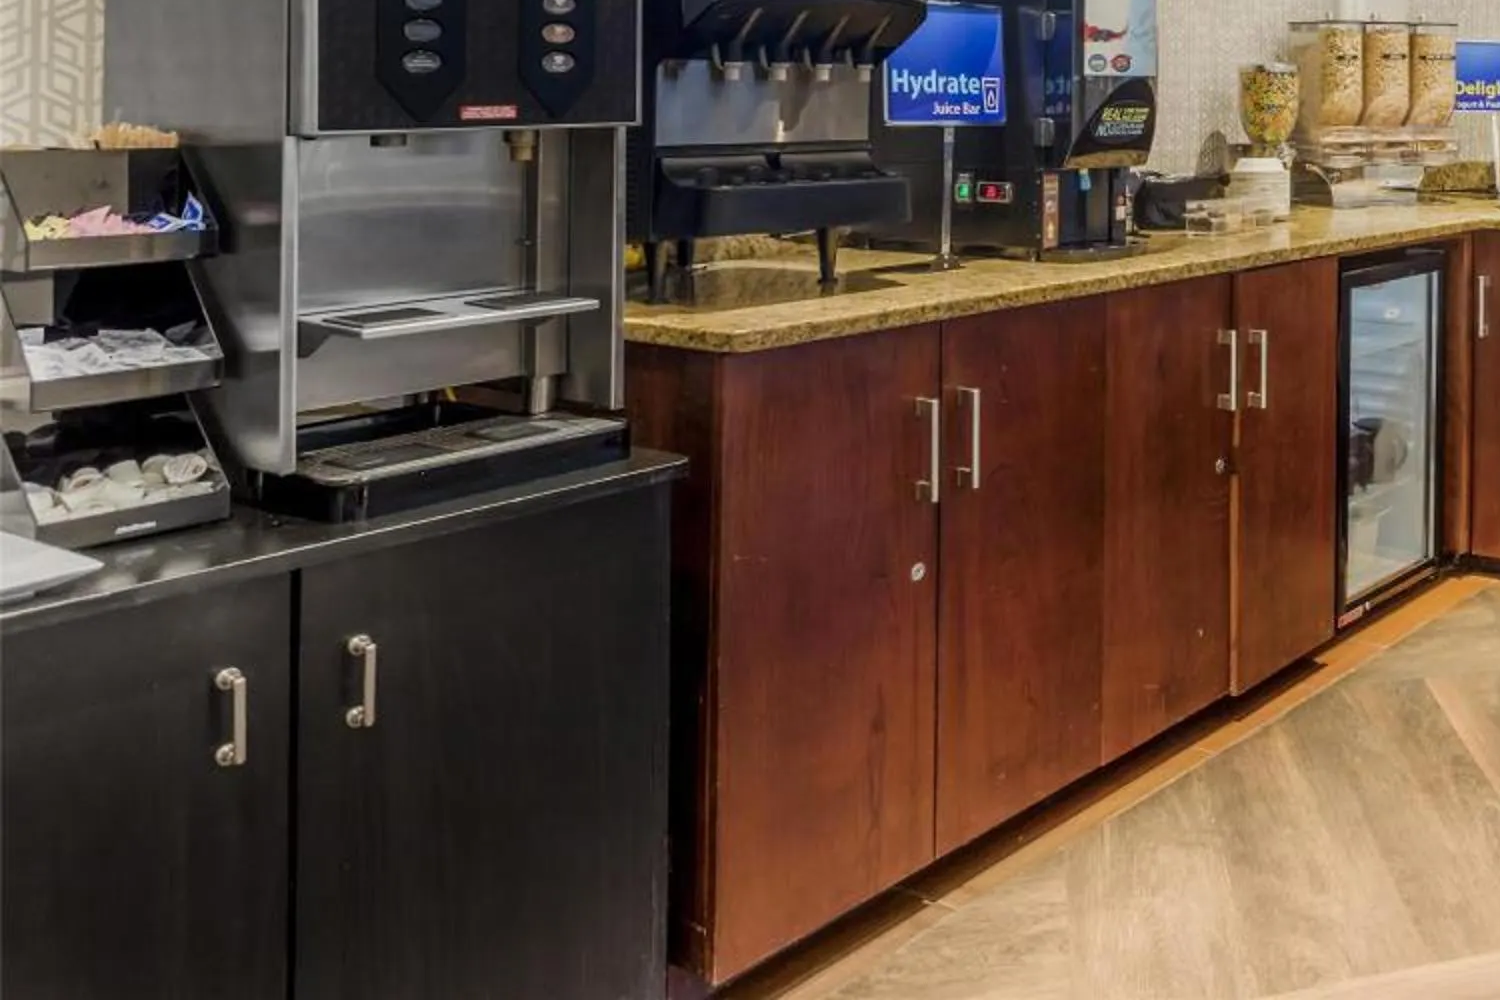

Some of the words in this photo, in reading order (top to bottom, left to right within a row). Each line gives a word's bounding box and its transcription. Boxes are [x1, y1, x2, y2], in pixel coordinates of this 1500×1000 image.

[891, 68, 981, 100] Hydrate
[932, 101, 960, 115] Juice
[962, 101, 981, 115] Bar
